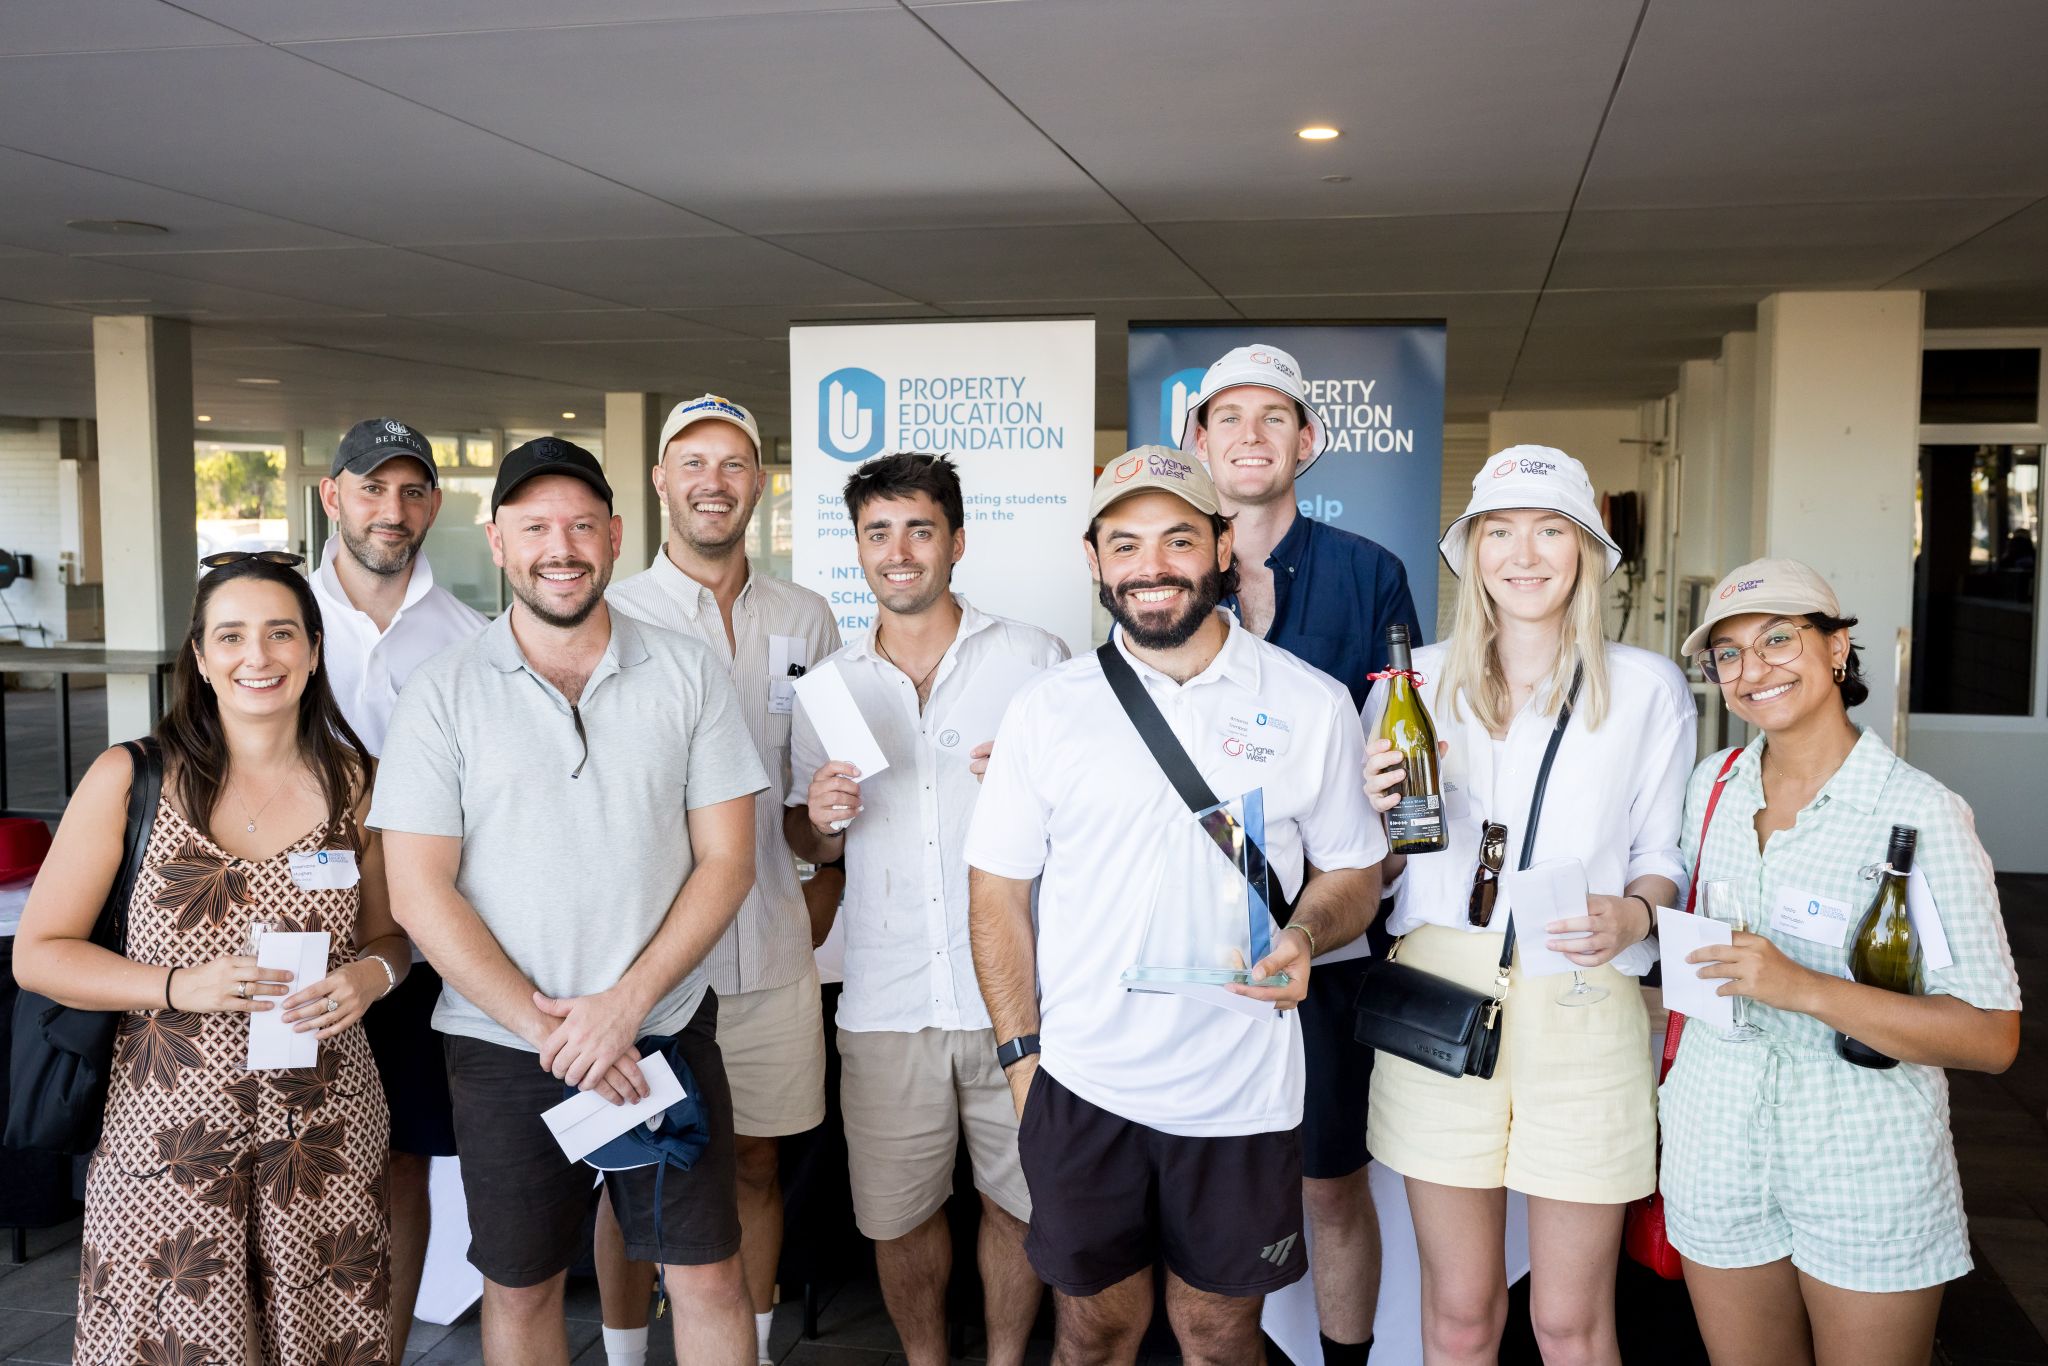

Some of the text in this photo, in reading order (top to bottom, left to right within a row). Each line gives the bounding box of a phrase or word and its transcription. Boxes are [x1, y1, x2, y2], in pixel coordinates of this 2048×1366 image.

[899, 376, 1026, 401] PROPERTY
[1302, 379, 1377, 403] PERTY
[899, 402, 1043, 426] EDUCATION
[1317, 404, 1393, 428] ATION
[375, 434, 422, 452] BERETTA
[899, 426, 1064, 450] FOUNDATION
[1325, 429, 1414, 453] DATION
[1148, 454, 1194, 475] Cygnet
[1519, 458, 1557, 471] Cygnet
[1520, 466, 1548, 476] West
[1149, 466, 1186, 480] West
[817, 494, 844, 506] Sup
[1005, 493, 1068, 505] students
[817, 509, 844, 520] into
[975, 509, 988, 520] in
[992, 509, 1015, 520] the
[1297, 494, 1344, 522] elp
[817, 527, 856, 539] prope
[831, 566, 865, 580] INT
[831, 591, 877, 604] SCHO
[1245, 742, 1275, 757] Cygnet
[1245, 751, 1268, 763] West
